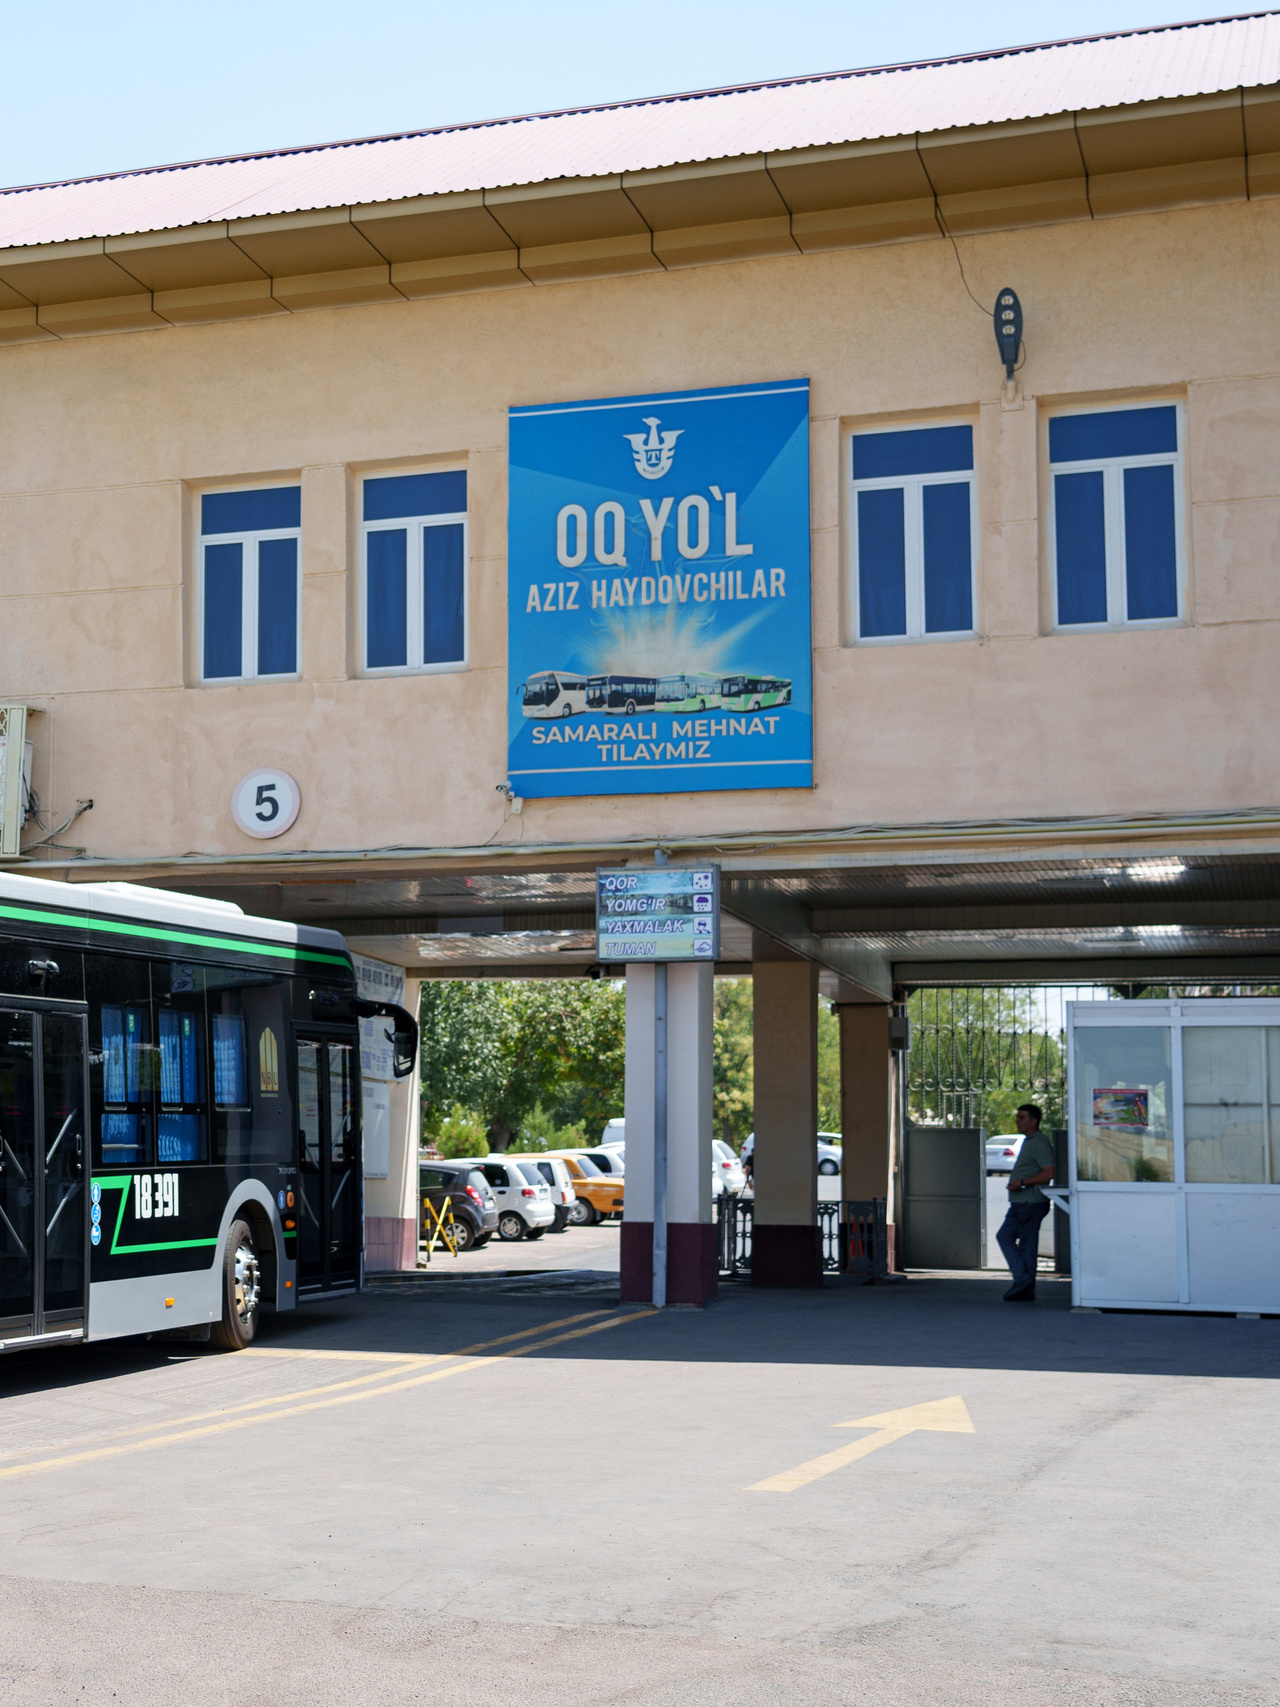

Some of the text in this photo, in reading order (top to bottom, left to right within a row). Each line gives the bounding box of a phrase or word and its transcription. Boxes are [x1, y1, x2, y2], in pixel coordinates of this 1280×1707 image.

[556, 500, 627, 568] OQ
[526, 568, 786, 613] AZIZ HAYDOVCHILAR
[531, 716, 780, 745] SAMARALI MEHNAT
[597, 740, 711, 762] TILAYMIZ
[255, 783, 280, 822] 5
[605, 876, 638, 891] QOR
[605, 919, 685, 934] YAXMALAK
[605, 941, 657, 956] TUMAN
